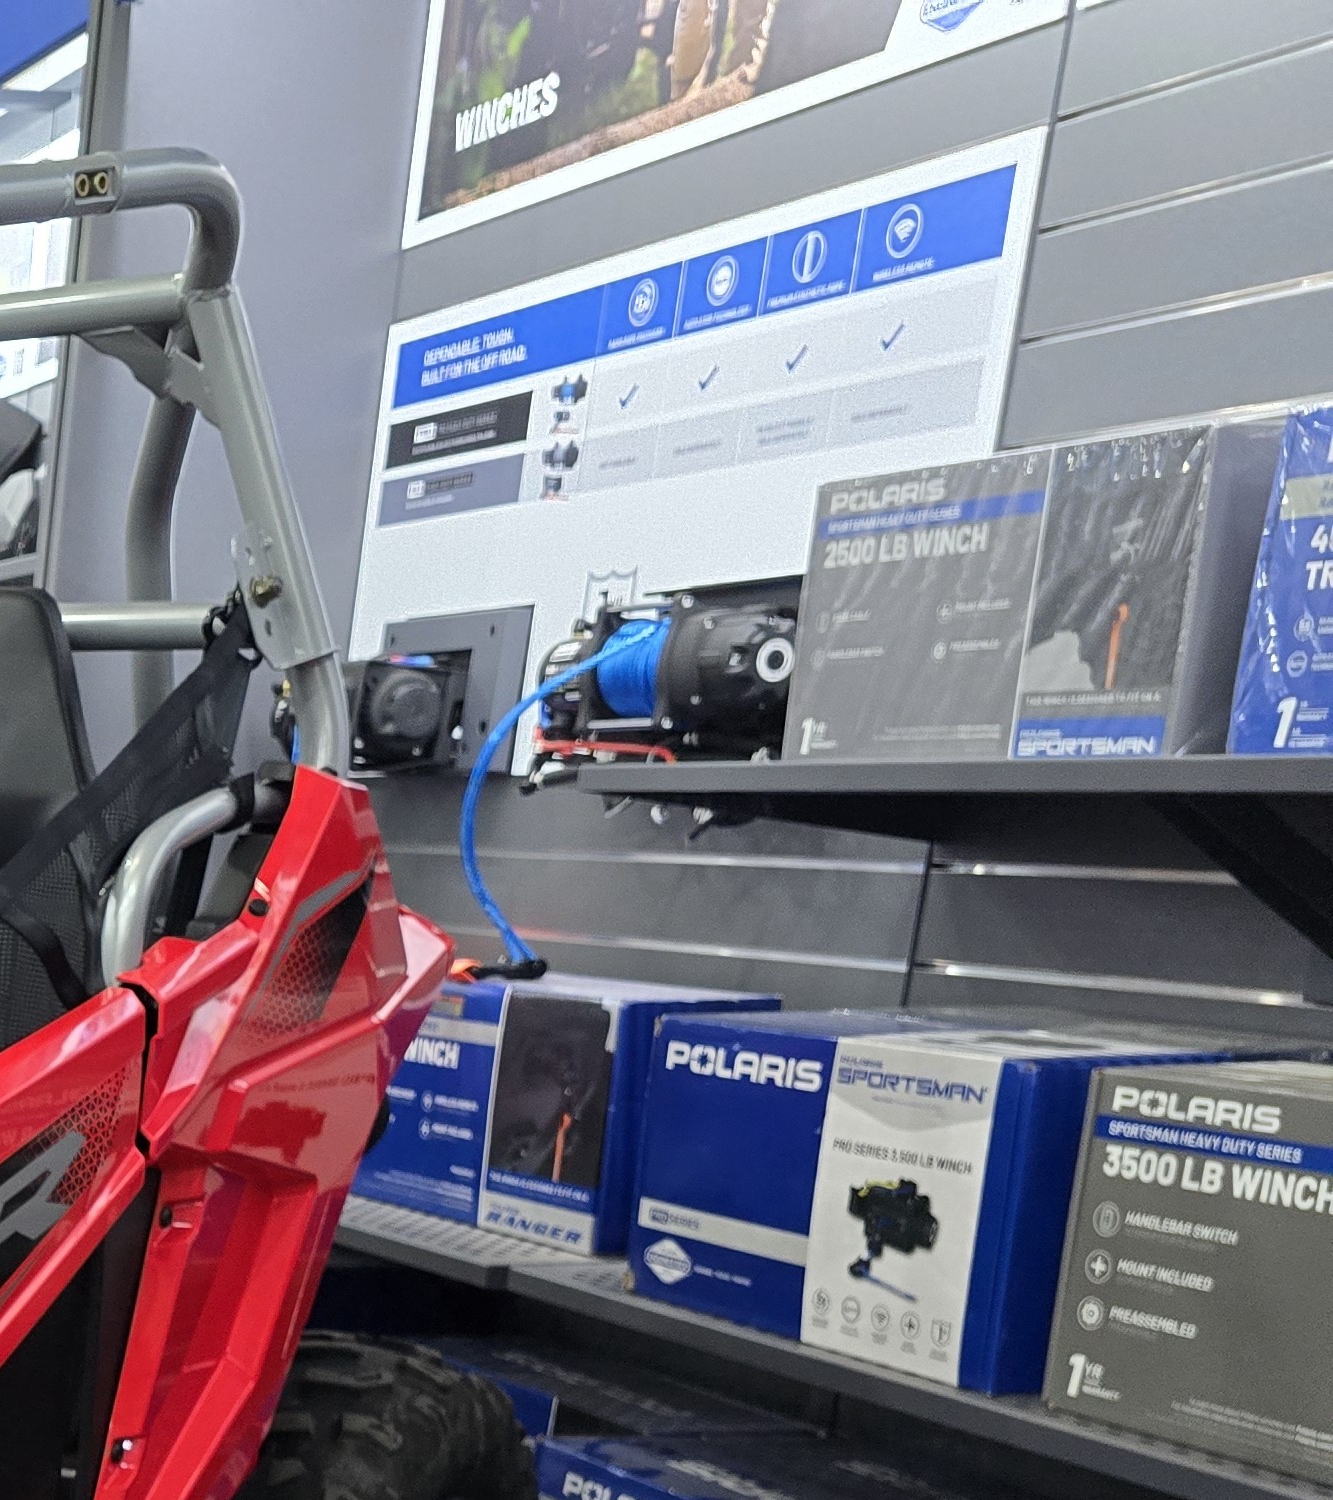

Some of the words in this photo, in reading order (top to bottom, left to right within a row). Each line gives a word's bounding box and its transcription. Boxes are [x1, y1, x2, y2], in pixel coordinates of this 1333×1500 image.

[454, 71, 561, 153] WINCHES
[830, 476, 946, 515] POLARIS
[823, 534, 876, 570] 2500
[878, 531, 909, 563] LB
[912, 521, 988, 560] WINCH
[799, 716, 815, 755] 1
[1272, 697, 1298, 749] 1
[1017, 736, 1157, 757] SPORTSMAN
[665, 1039, 824, 1093] POLARIS
[836, 1066, 988, 1104] SPORTSMAN
[1111, 1084, 1283, 1135] POLARIS
[832, 1137, 852, 1156] PRO
[854, 1140, 890, 1161] SERIES
[919, 1153, 934, 1169] LB
[935, 1156, 973, 1175] WINCH
[1107, 1119, 1179, 1146] SPORTSMAN
[1179, 1129, 1221, 1152] HEAVY
[1220, 1136, 1256, 1158] DUTY
[1256, 1141, 1304, 1165] SERIES
[1102, 1143, 1179, 1187] 3500
[1180, 1155, 1225, 1195] LB
[485, 1209, 582, 1245] RANGER
[1124, 1209, 1193, 1232] HANDLEBAR
[1192, 1222, 1240, 1246] SWITCH
[1116, 1257, 1156, 1280] MOUNT
[1155, 1265, 1216, 1293] INCLUDED
[1108, 1304, 1200, 1340] PREASSEMBLED
[1066, 1352, 1086, 1399] 1
